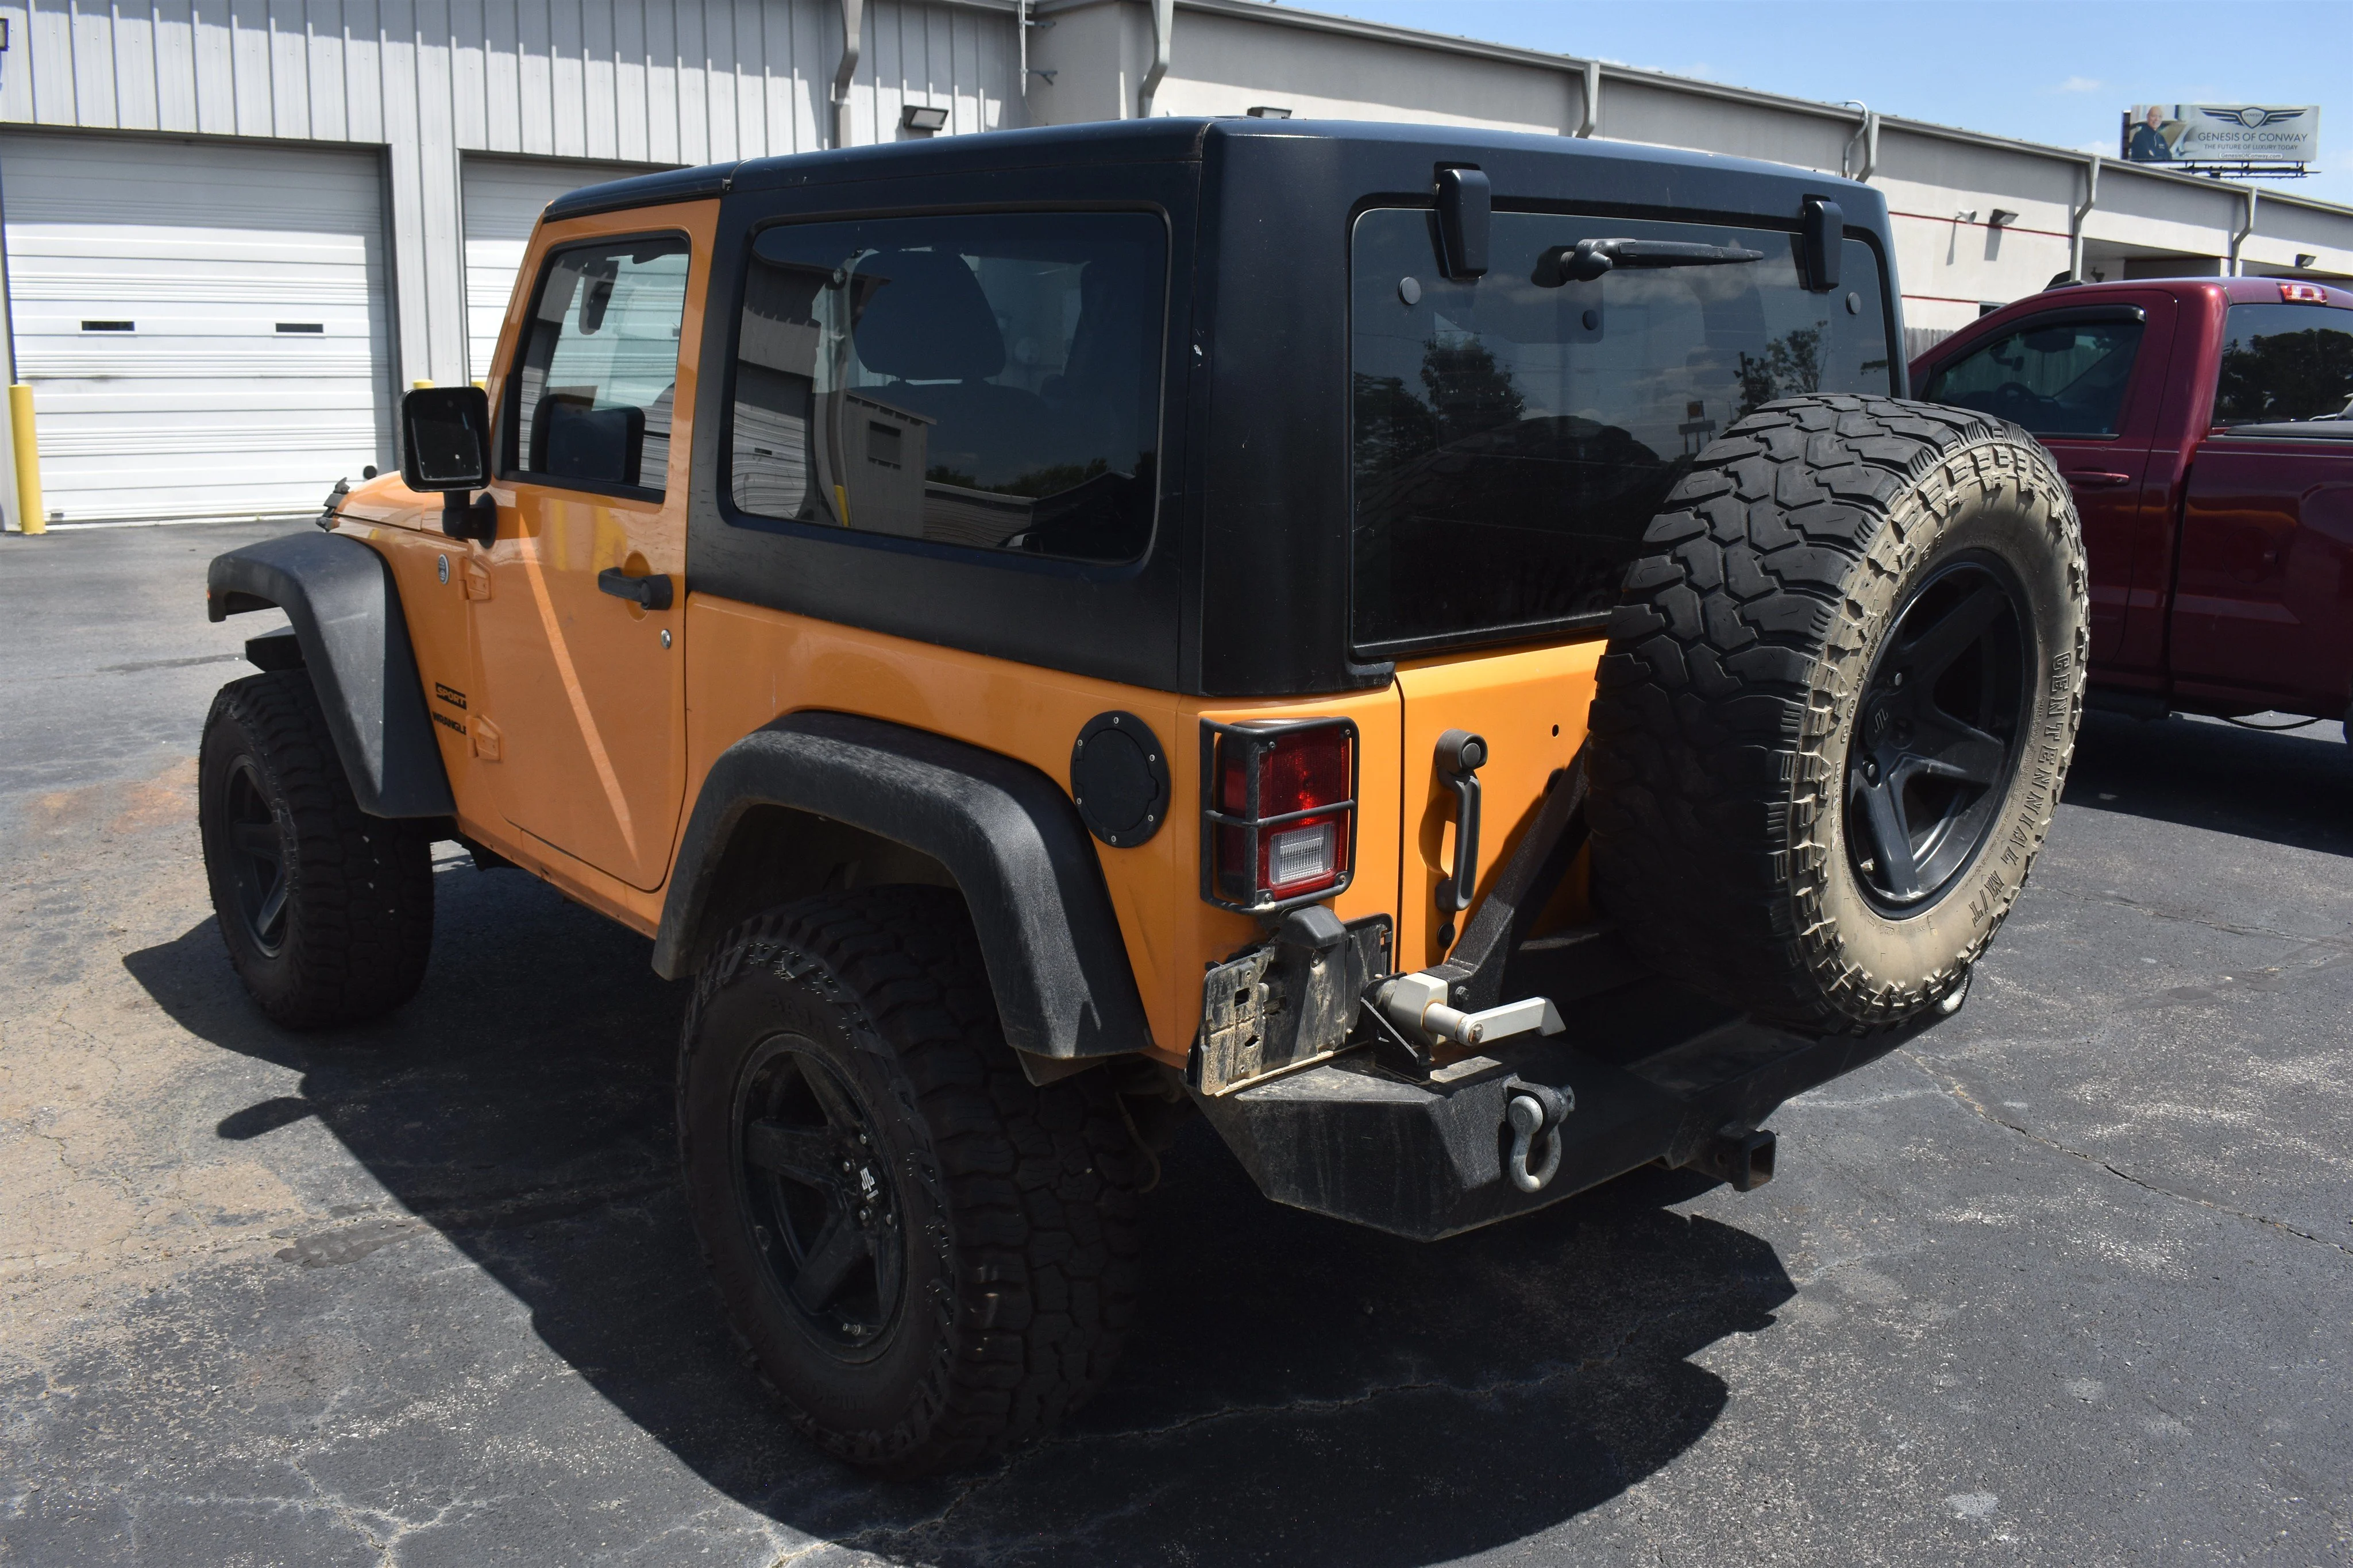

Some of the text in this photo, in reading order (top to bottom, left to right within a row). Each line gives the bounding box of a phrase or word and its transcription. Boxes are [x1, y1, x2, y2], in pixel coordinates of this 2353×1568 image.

[2198, 132, 2308, 142] GENESIS OF CONWAY
[436, 685, 466, 707] SPORT
[432, 711, 466, 736] WRANGLE
[2000, 651, 2072, 866] CENTENNIAL
[1968, 870, 2006, 928] M/T
